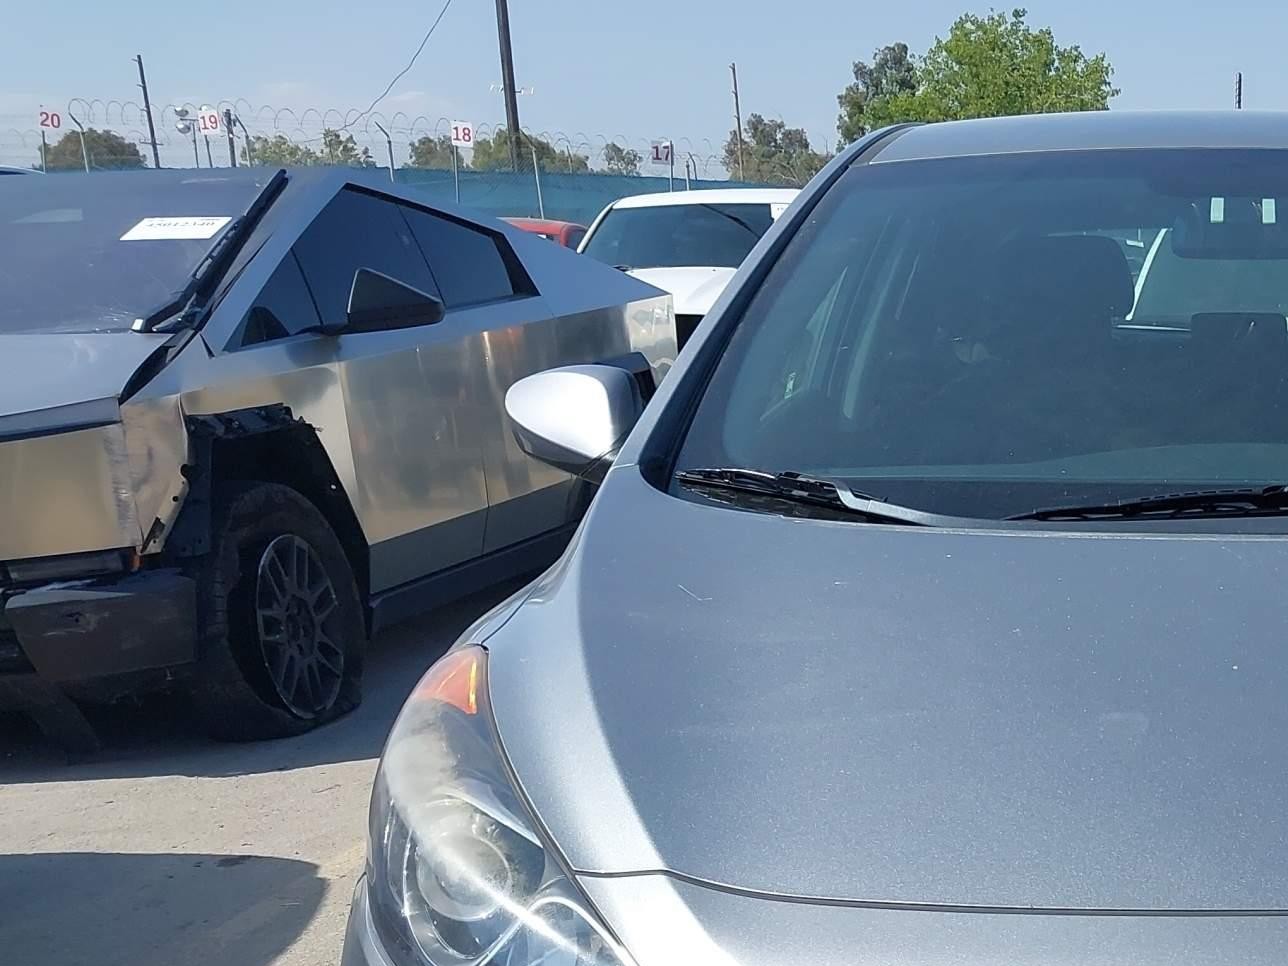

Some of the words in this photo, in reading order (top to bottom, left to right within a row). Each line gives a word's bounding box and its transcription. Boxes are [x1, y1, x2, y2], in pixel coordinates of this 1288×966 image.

[39, 111, 61, 129] 20
[200, 114, 218, 130] 19
[452, 126, 471, 142] 18
[652, 145, 671, 161] 17
